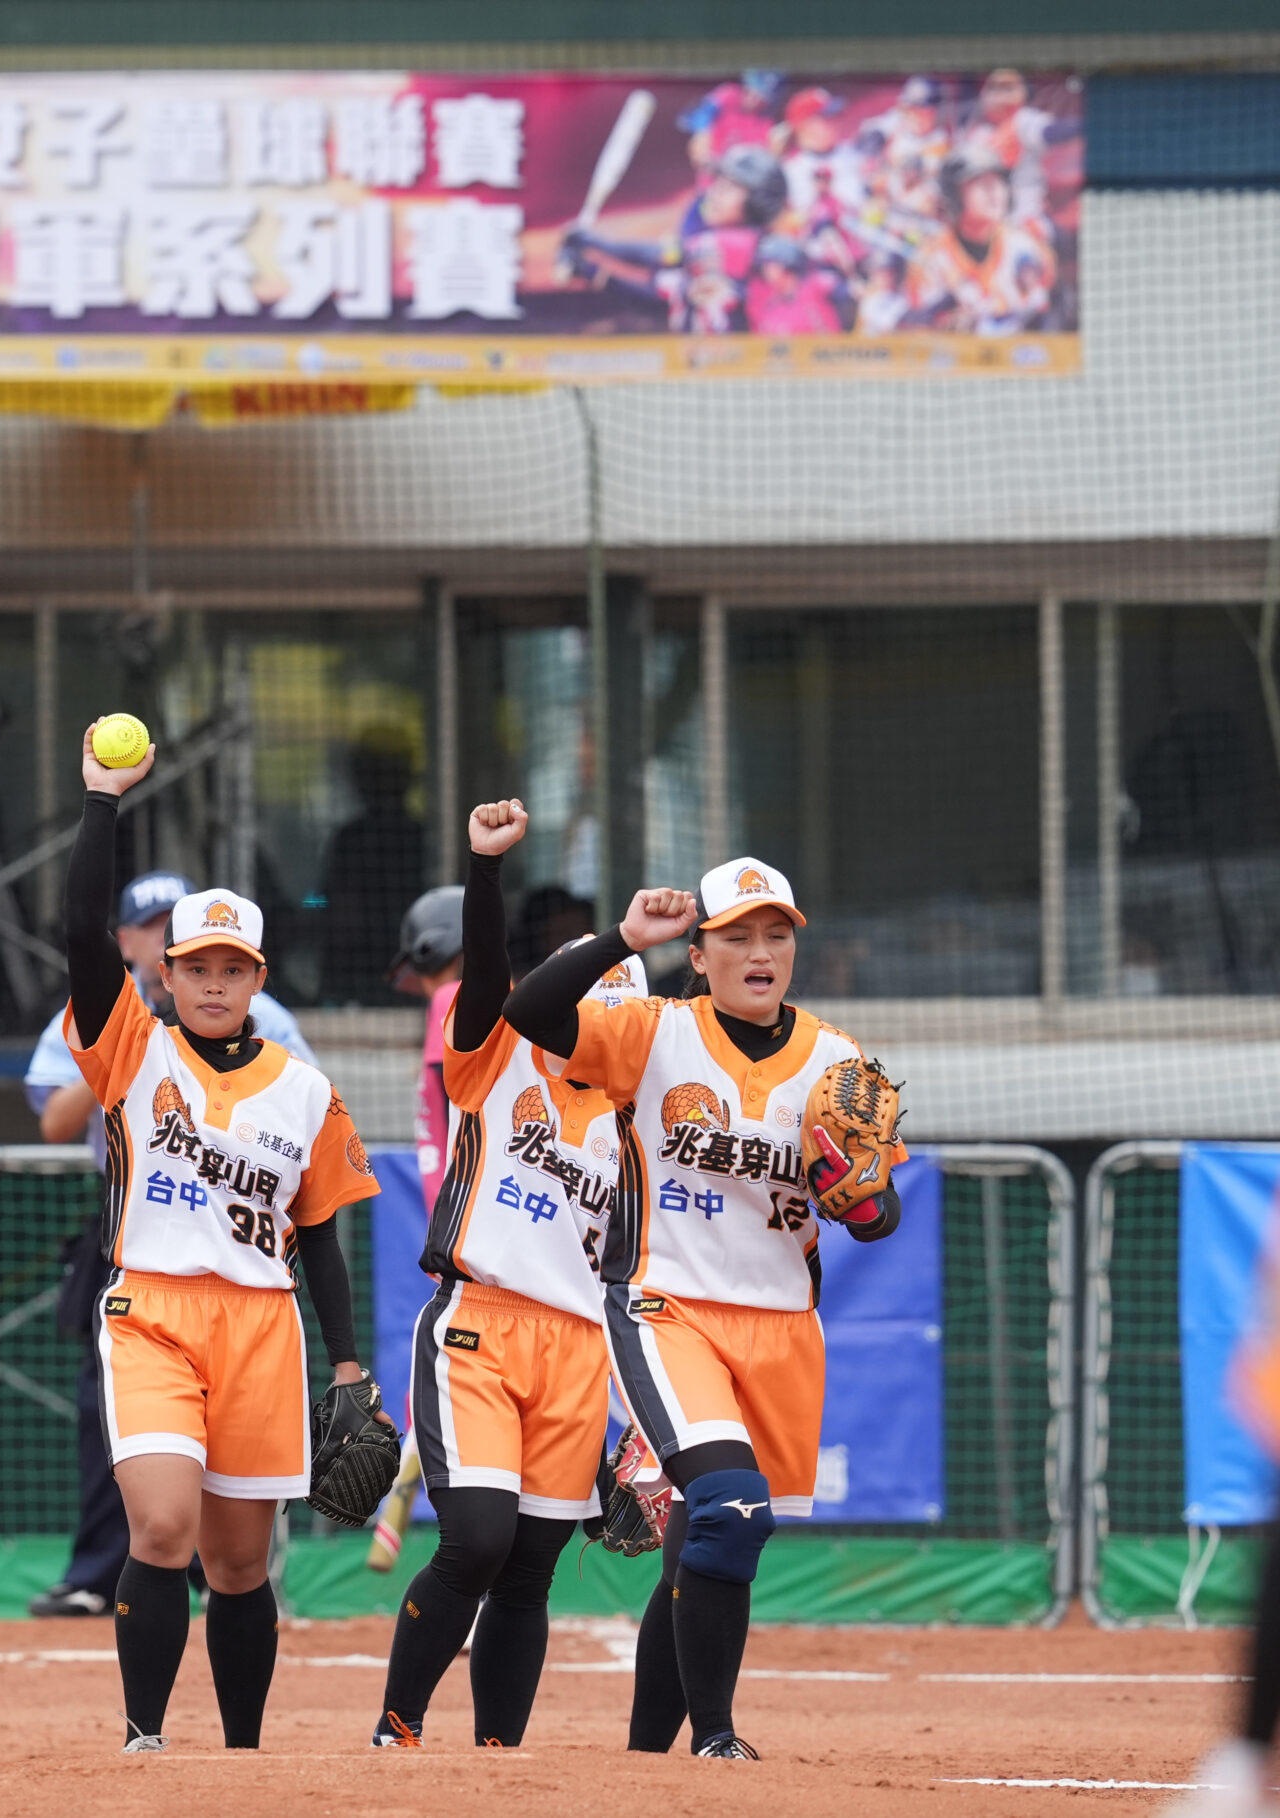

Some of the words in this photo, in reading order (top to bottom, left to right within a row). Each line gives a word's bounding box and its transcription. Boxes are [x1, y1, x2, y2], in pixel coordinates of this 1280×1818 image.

[662, 1125, 805, 1186] 兆基穿山
[146, 1170, 208, 1212] 台中
[496, 1175, 558, 1223] 台中
[659, 1178, 724, 1220] 台中
